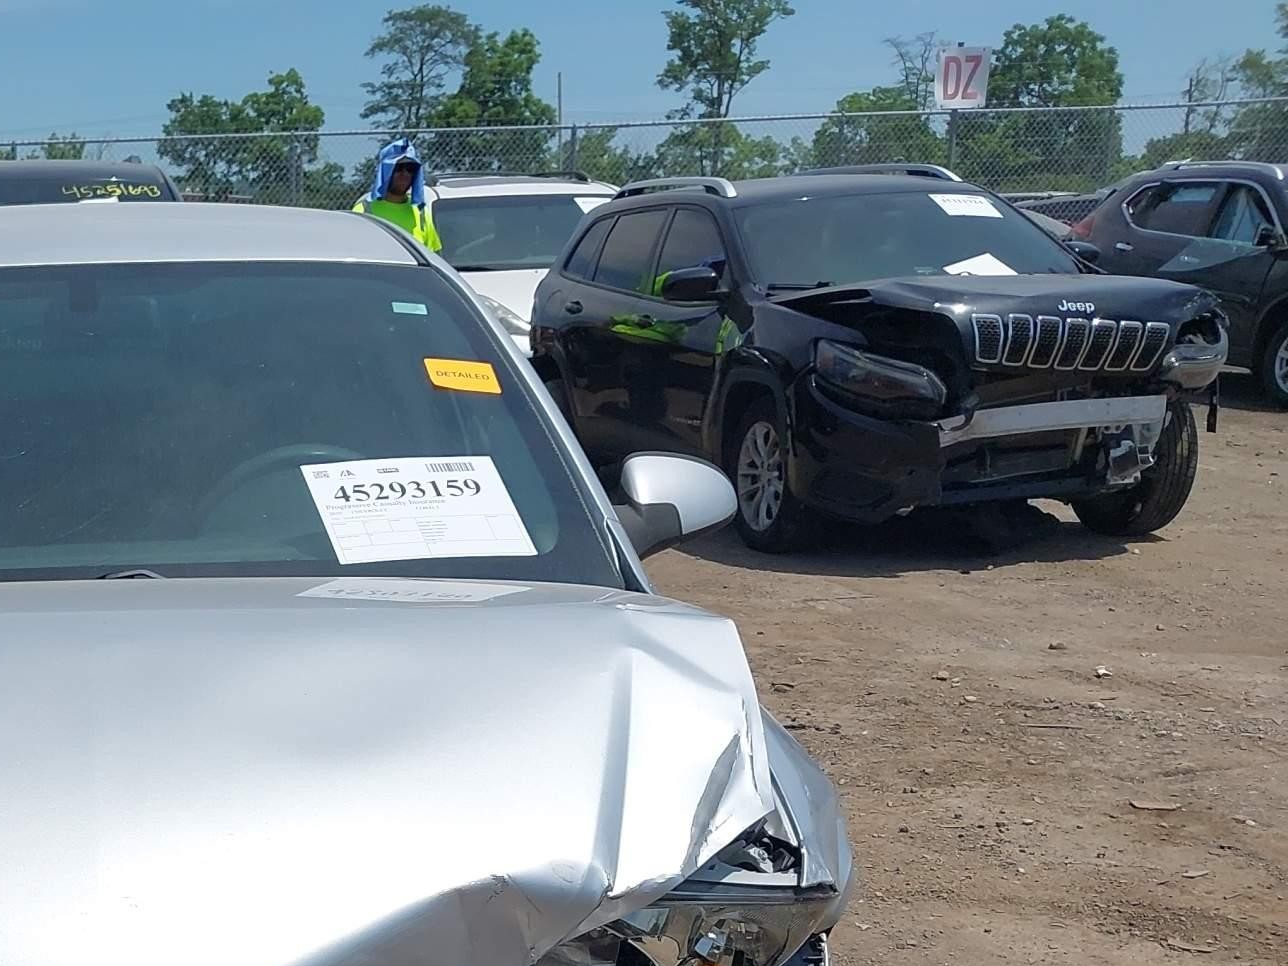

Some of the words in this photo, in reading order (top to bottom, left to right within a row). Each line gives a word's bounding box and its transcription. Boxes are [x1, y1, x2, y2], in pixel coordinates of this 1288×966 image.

[943, 54, 983, 101] DZ
[1057, 299, 1095, 314] Jeep
[435, 370, 490, 381] DETAILED
[333, 478, 482, 503] 45293159
